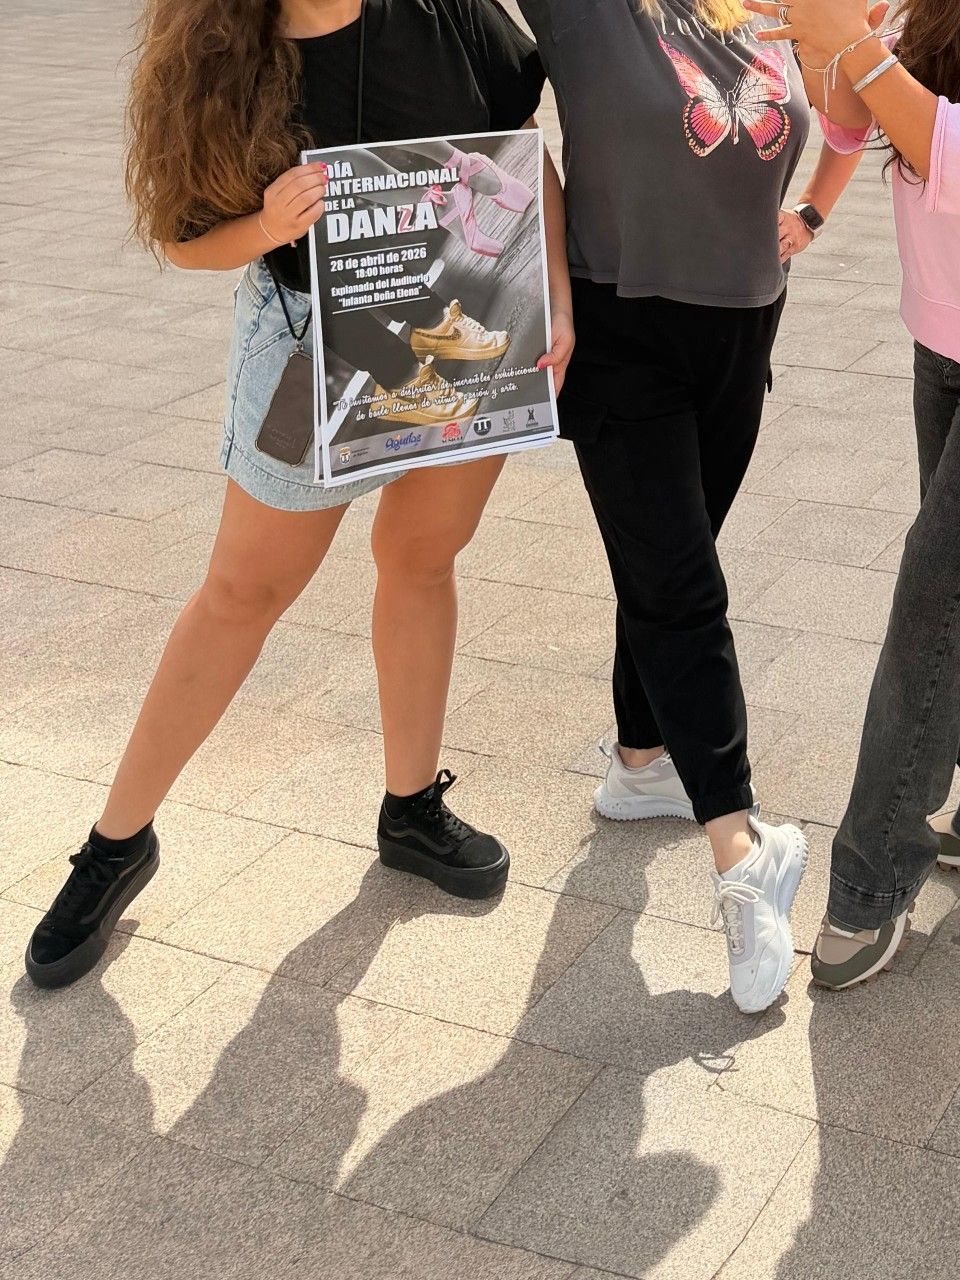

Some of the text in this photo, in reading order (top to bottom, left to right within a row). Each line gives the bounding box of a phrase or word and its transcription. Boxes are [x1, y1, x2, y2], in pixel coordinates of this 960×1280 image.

[326, 161, 354, 179] DÍA
[325, 167, 460, 197] INTERNACIONAL
[324, 198, 356, 212] DE LA
[326, 201, 438, 244] DANZA
[330, 246, 427, 272] 28 de abril de 2026
[354, 263, 404, 279] 18:00 horas
[331, 272, 432, 297] Explanada del Auditorio
[373, 290, 396, 303] Doña
[491, 388, 498, 400] y
